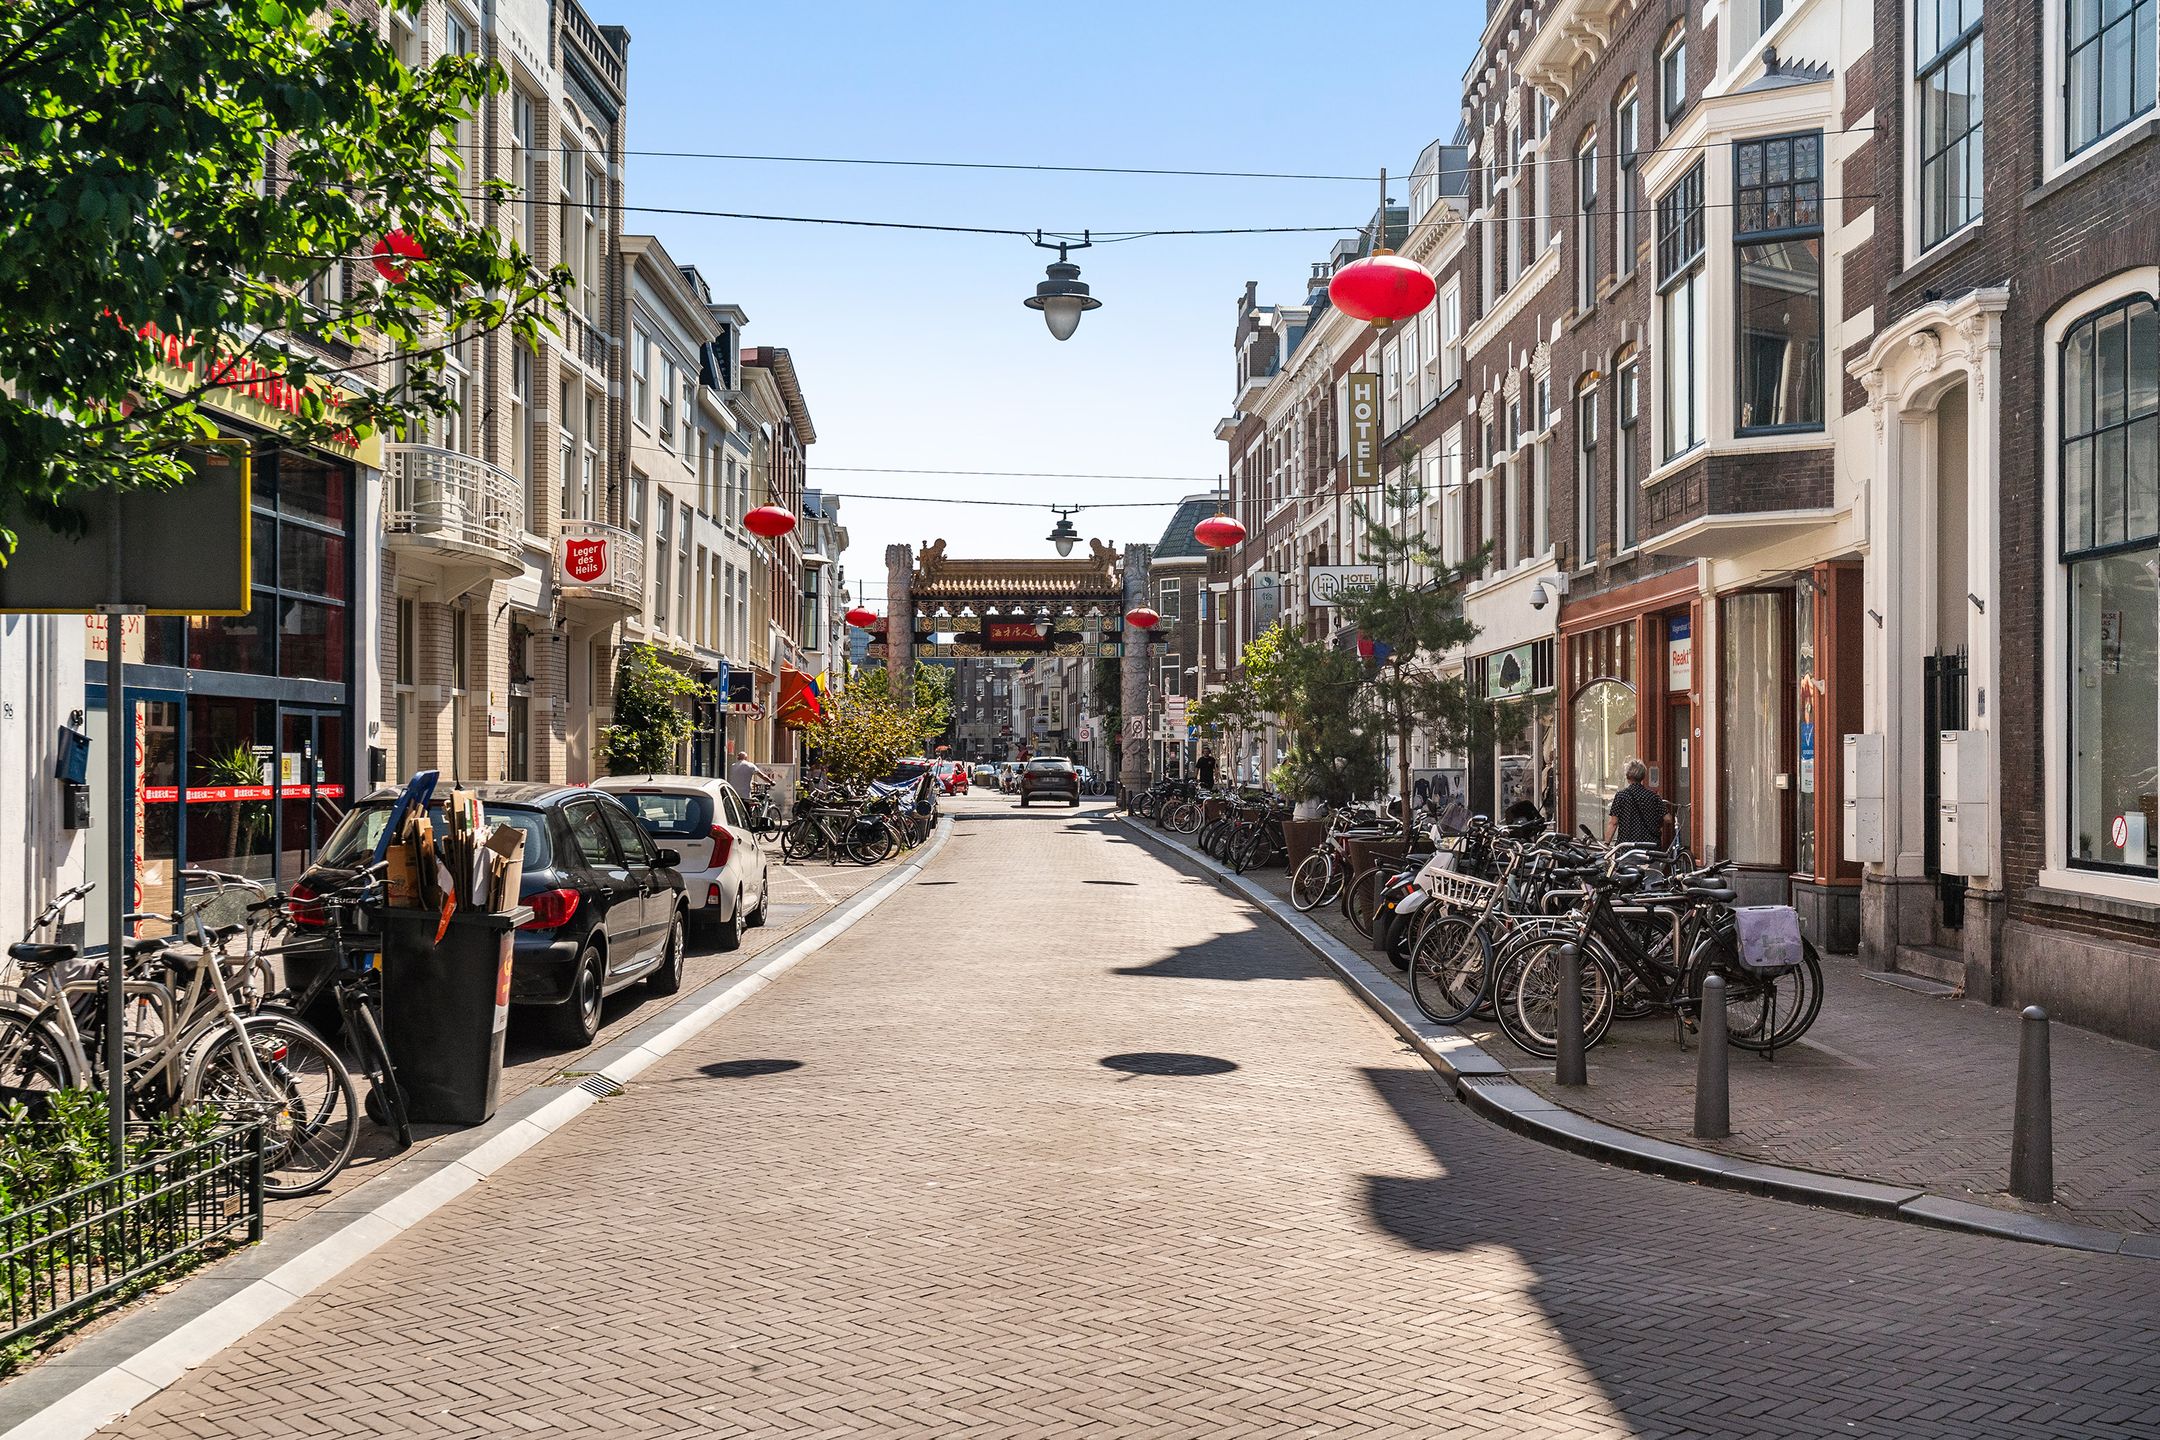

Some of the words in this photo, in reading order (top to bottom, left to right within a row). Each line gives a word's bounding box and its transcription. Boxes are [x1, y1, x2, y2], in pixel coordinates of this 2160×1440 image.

[1354, 383, 1372, 477] HOTEL
[573, 545, 598, 557] Leger
[578, 556, 594, 565] des
[575, 563, 598, 575] Heils
[1341, 574, 1376, 583] HOTEL
[1672, 650, 1689, 667] Reakt
[722, 665, 728, 687] P
